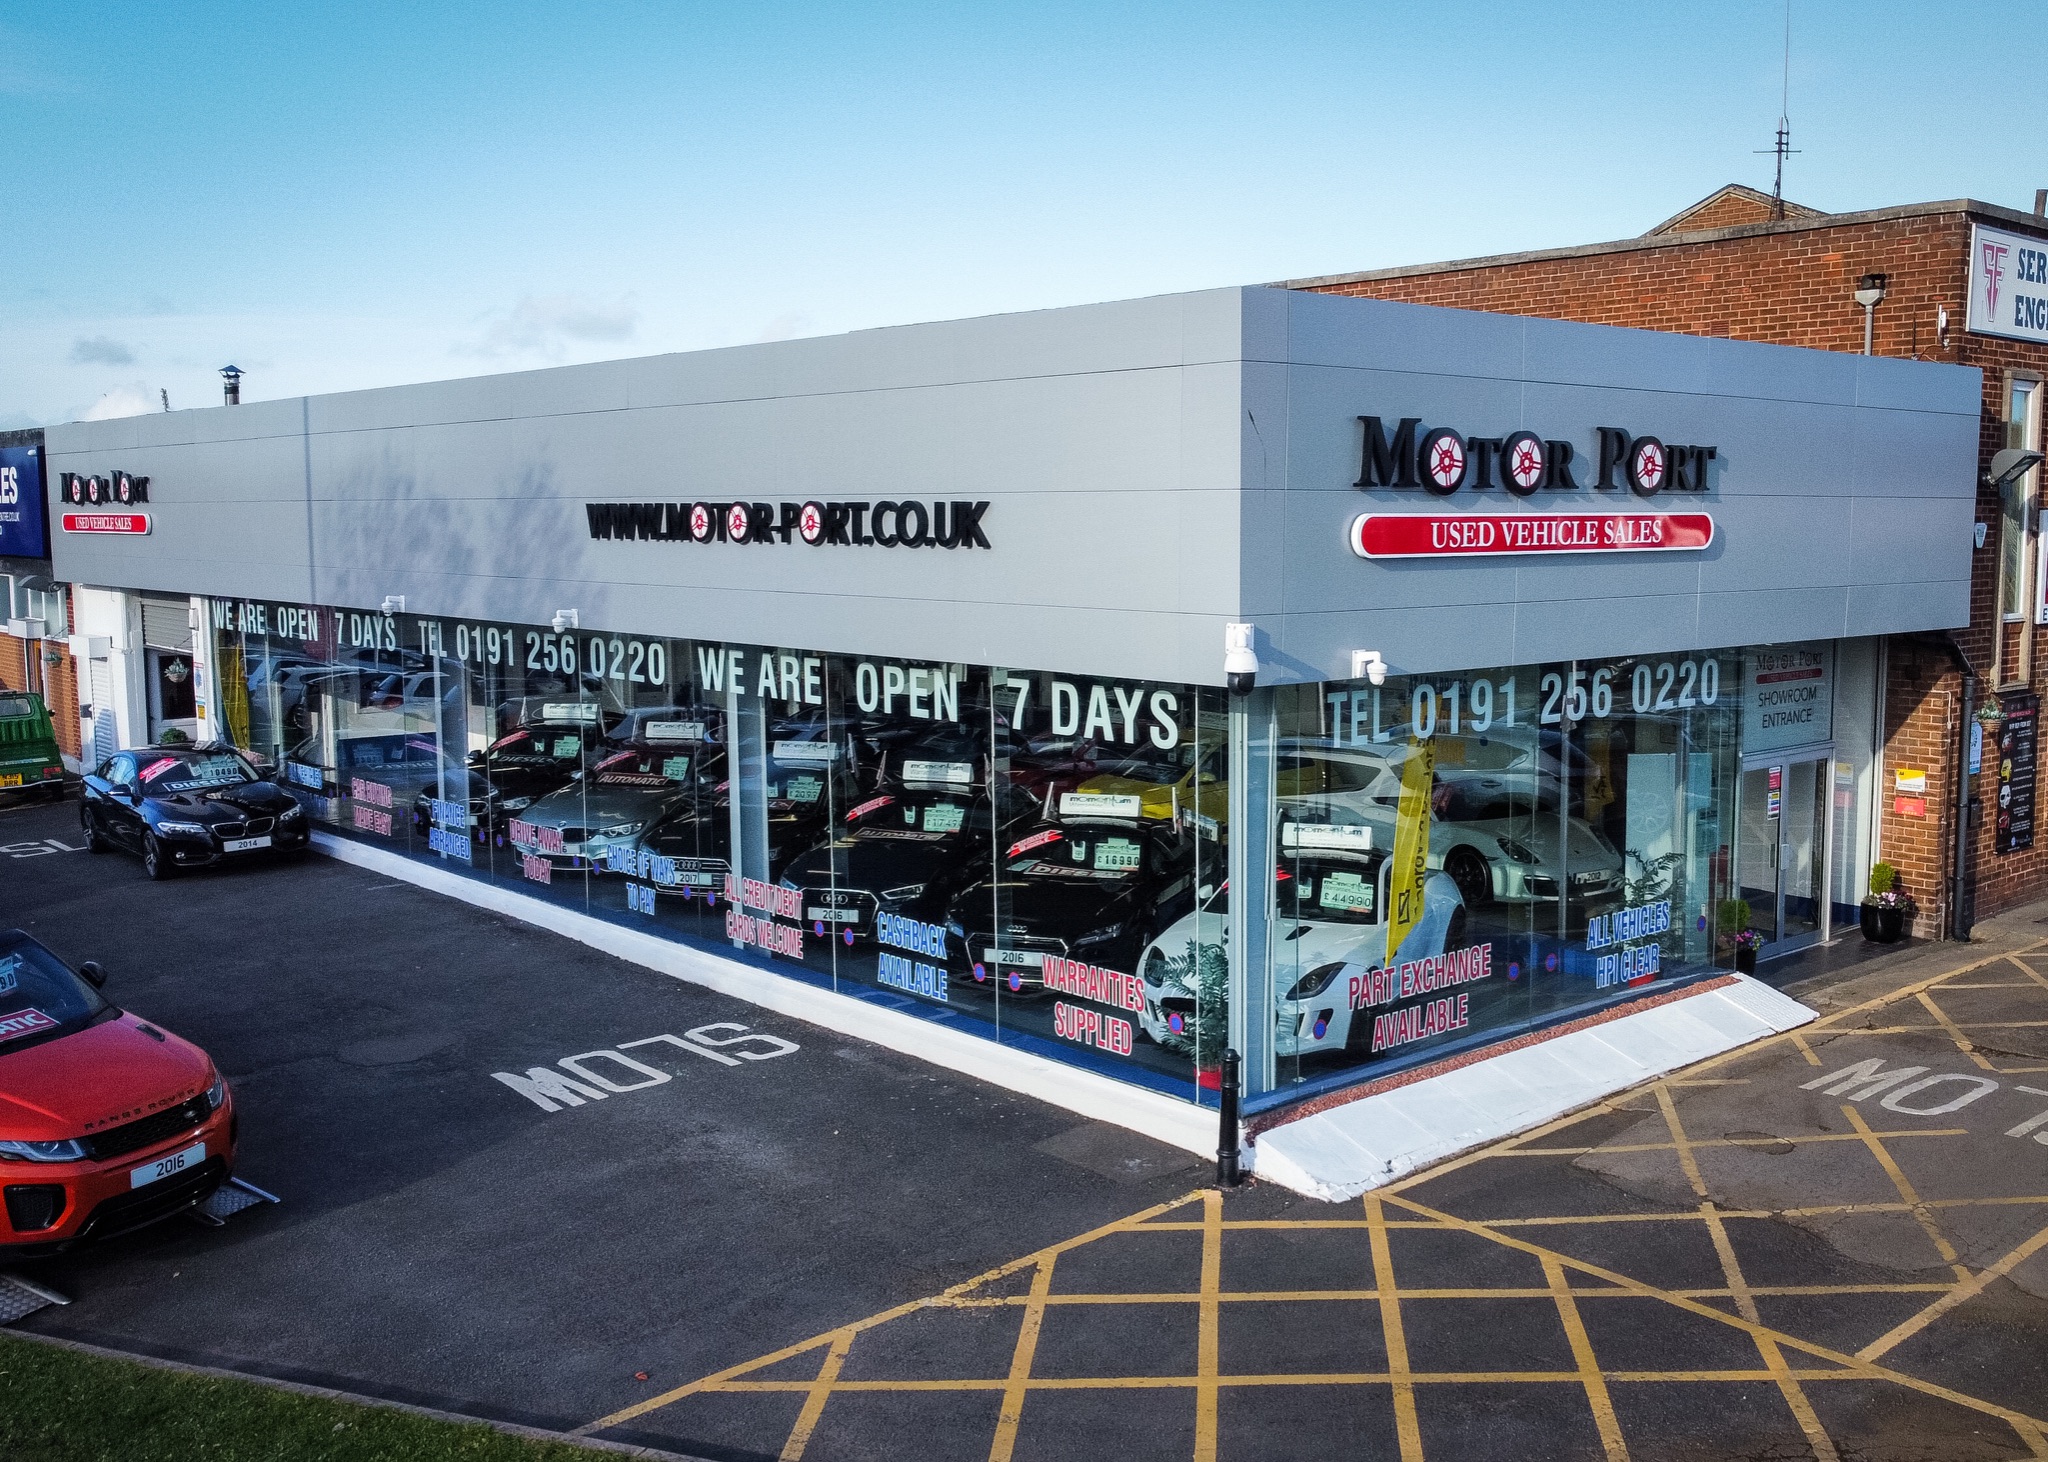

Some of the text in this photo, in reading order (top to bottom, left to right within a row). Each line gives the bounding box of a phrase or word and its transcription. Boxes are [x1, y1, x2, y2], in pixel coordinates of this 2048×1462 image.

[2014, 294, 2048, 331] ENG
[1353, 415, 1718, 498] MOTOR PORT
[75, 516, 132, 530] USED VEHICLE SALES
[1430, 519, 1662, 549] USED VEHICLE SALES
[212, 600, 1179, 750] WE ARE OPEN 7 DAYS TEL 0191 256 0220 WE ARE OPEN 7 DAYS
[1326, 658, 1719, 749] TEL 0191 256 0220
[1758, 686, 1817, 707] SHOWROOM
[1762, 708, 1812, 729] ENTRANCE
[600, 775, 664, 785] AUTOMATIC
[431, 798, 466, 829] FINANCE
[1069, 795, 1132, 807] momentum
[238, 840, 258, 849] 2014
[429, 827, 472, 860] ARRANGED
[509, 817, 564, 855] DRIVE AWAY
[1293, 825, 1363, 837] momentum
[522, 853, 552, 885] TODAY
[606, 844, 676, 886] CHOICE OF WAYS
[680, 874, 697, 883] 2017
[626, 882, 657, 916] TO PAY
[724, 872, 741, 903] ALL
[725, 909, 804, 960] CARDS WELCOME
[877, 910, 948, 961] CASHBACK
[1586, 901, 1671, 951] ALL VEHICLES
[1002, 951, 1024, 963] 2016
[1595, 943, 1661, 990] HPI CLEAR
[877, 951, 949, 1002] AVAILABLE
[1042, 953, 1146, 1013] WARRANTIES
[1349, 942, 1492, 1012] PART EXCHANGE
[1054, 1001, 1133, 1057] SUPPLIED
[1371, 992, 1469, 1053] AVAILABLE
[84, 1087, 196, 1131] RANGE ROVER
[156, 1154, 185, 1177] 2016
